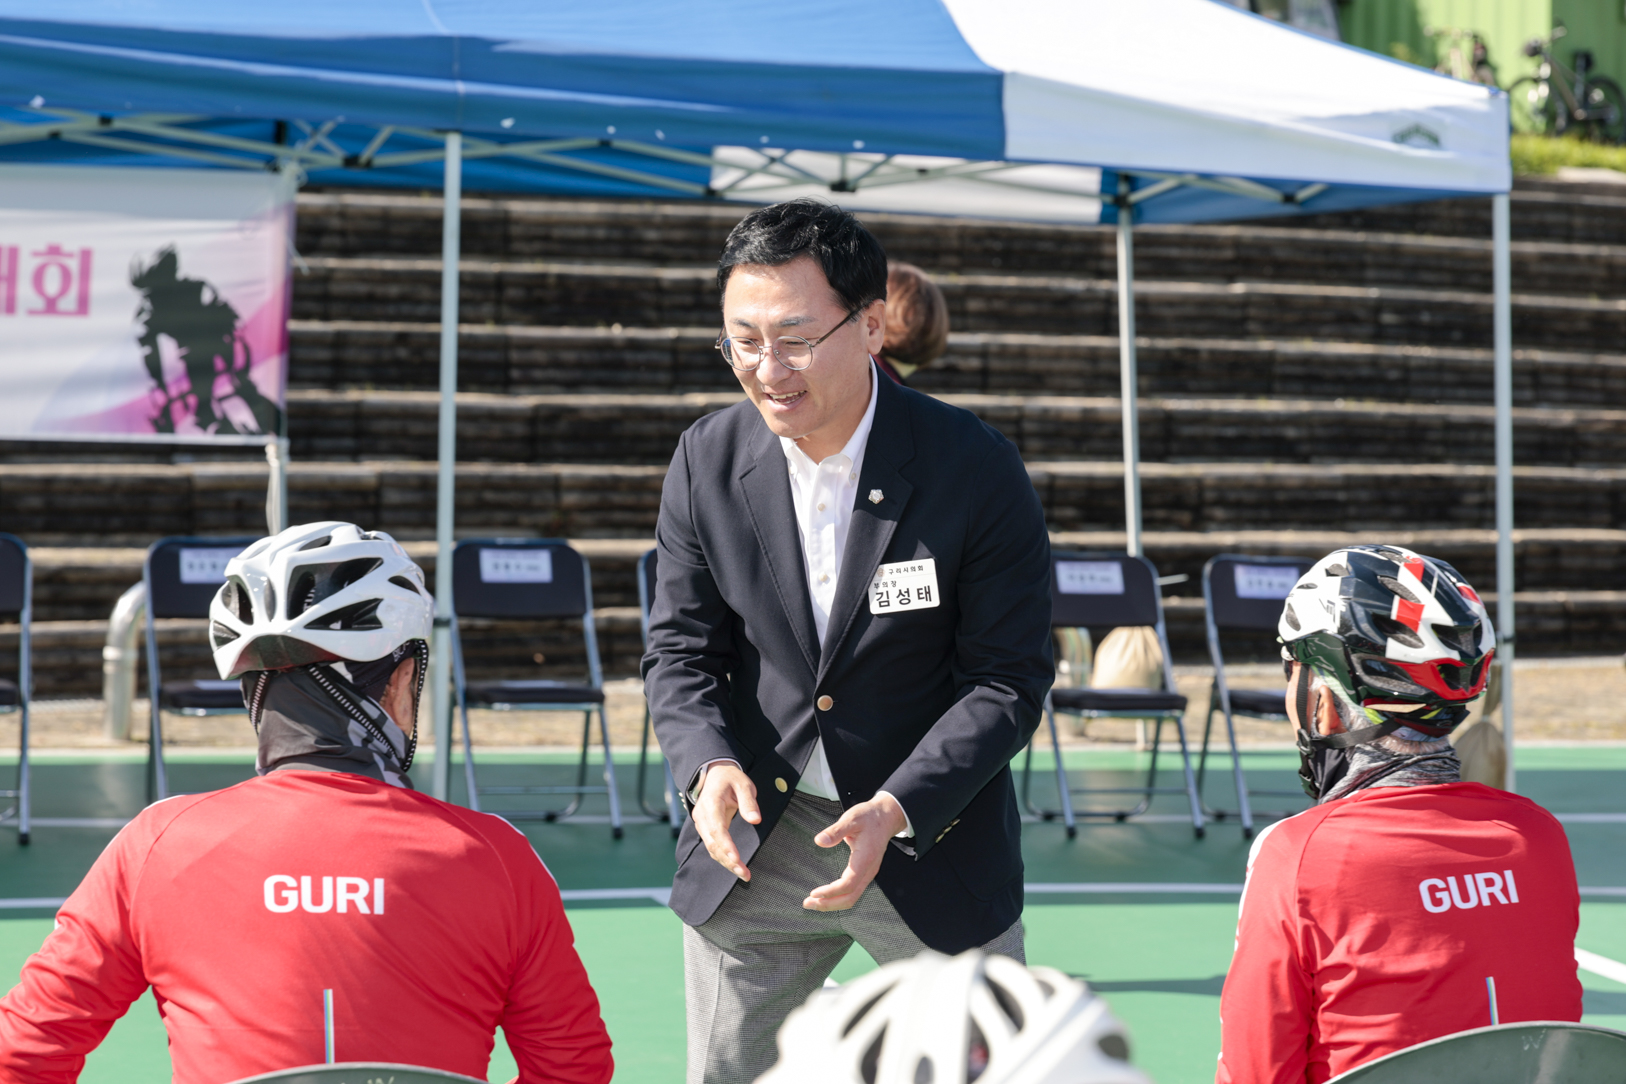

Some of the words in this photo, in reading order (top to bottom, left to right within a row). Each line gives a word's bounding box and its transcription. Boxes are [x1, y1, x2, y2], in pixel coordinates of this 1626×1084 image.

[888, 565, 924, 575] 구리시의회
[873, 580, 897, 589] 부의장
[875, 585, 932, 608] 김성태
[263, 874, 385, 915] GURI
[1418, 869, 1520, 914] GURI
